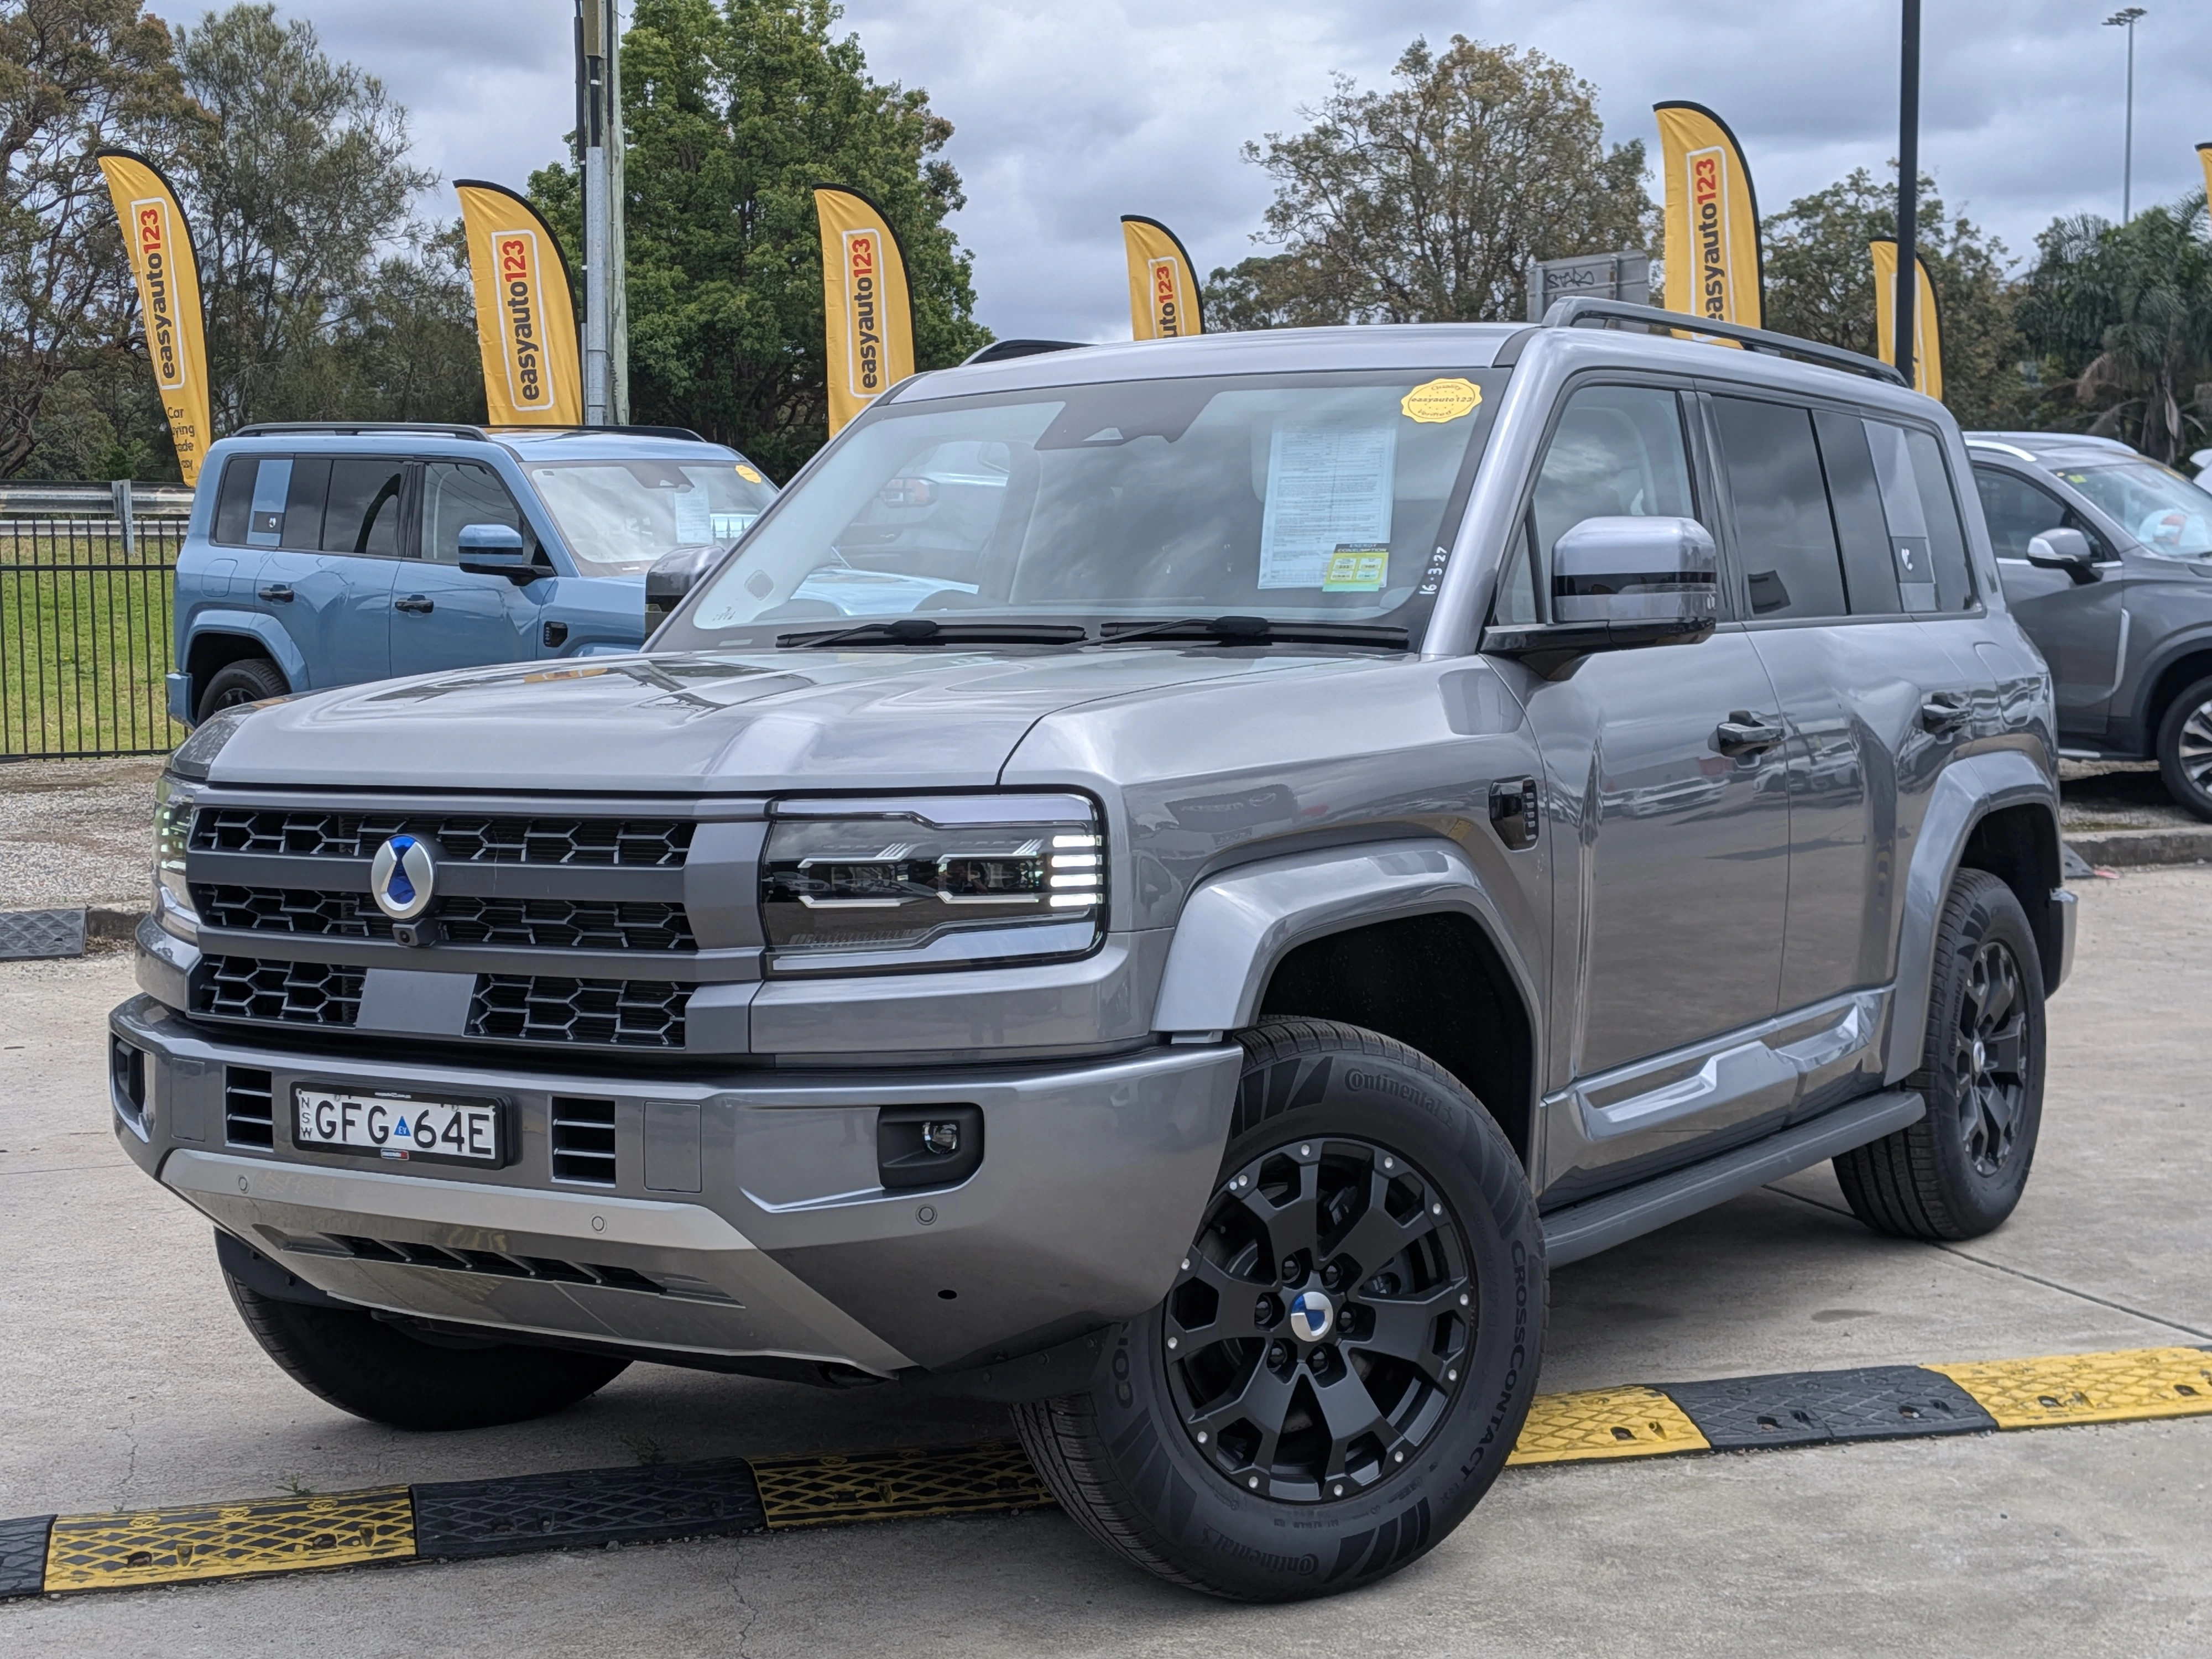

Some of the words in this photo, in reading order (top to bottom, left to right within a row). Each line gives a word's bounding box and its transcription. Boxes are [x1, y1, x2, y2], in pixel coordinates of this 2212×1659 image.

[140, 208, 175, 379] easyauto123
[502, 240, 539, 400] easyauto123
[851, 238, 879, 389] easyauto123
[167, 407, 184, 419] Car
[1344, 1068, 1442, 1117] Continental
[315, 1100, 389, 1145] GFG
[414, 1109, 492, 1155] 64E
[1213, 1532, 1319, 1576] Continental
